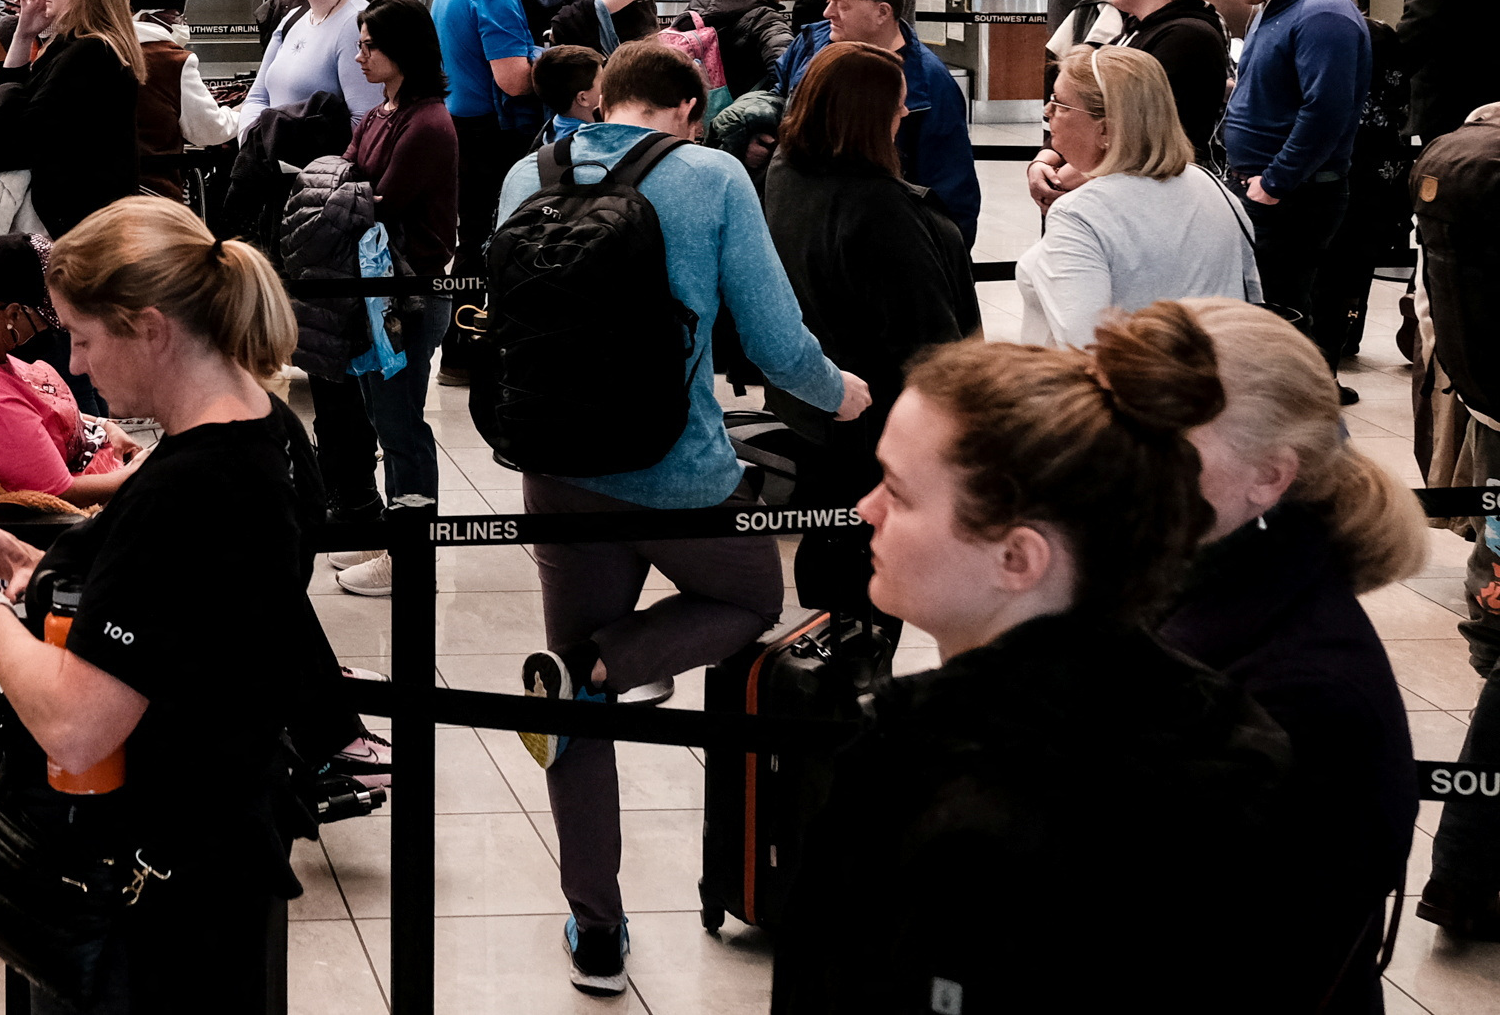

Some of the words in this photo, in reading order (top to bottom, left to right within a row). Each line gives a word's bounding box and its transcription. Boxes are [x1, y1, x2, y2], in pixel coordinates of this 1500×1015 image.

[974, 15, 1027, 23] SOUTHWEST
[429, 520, 519, 541] IRLINES
[103, 621, 135, 645] 100
